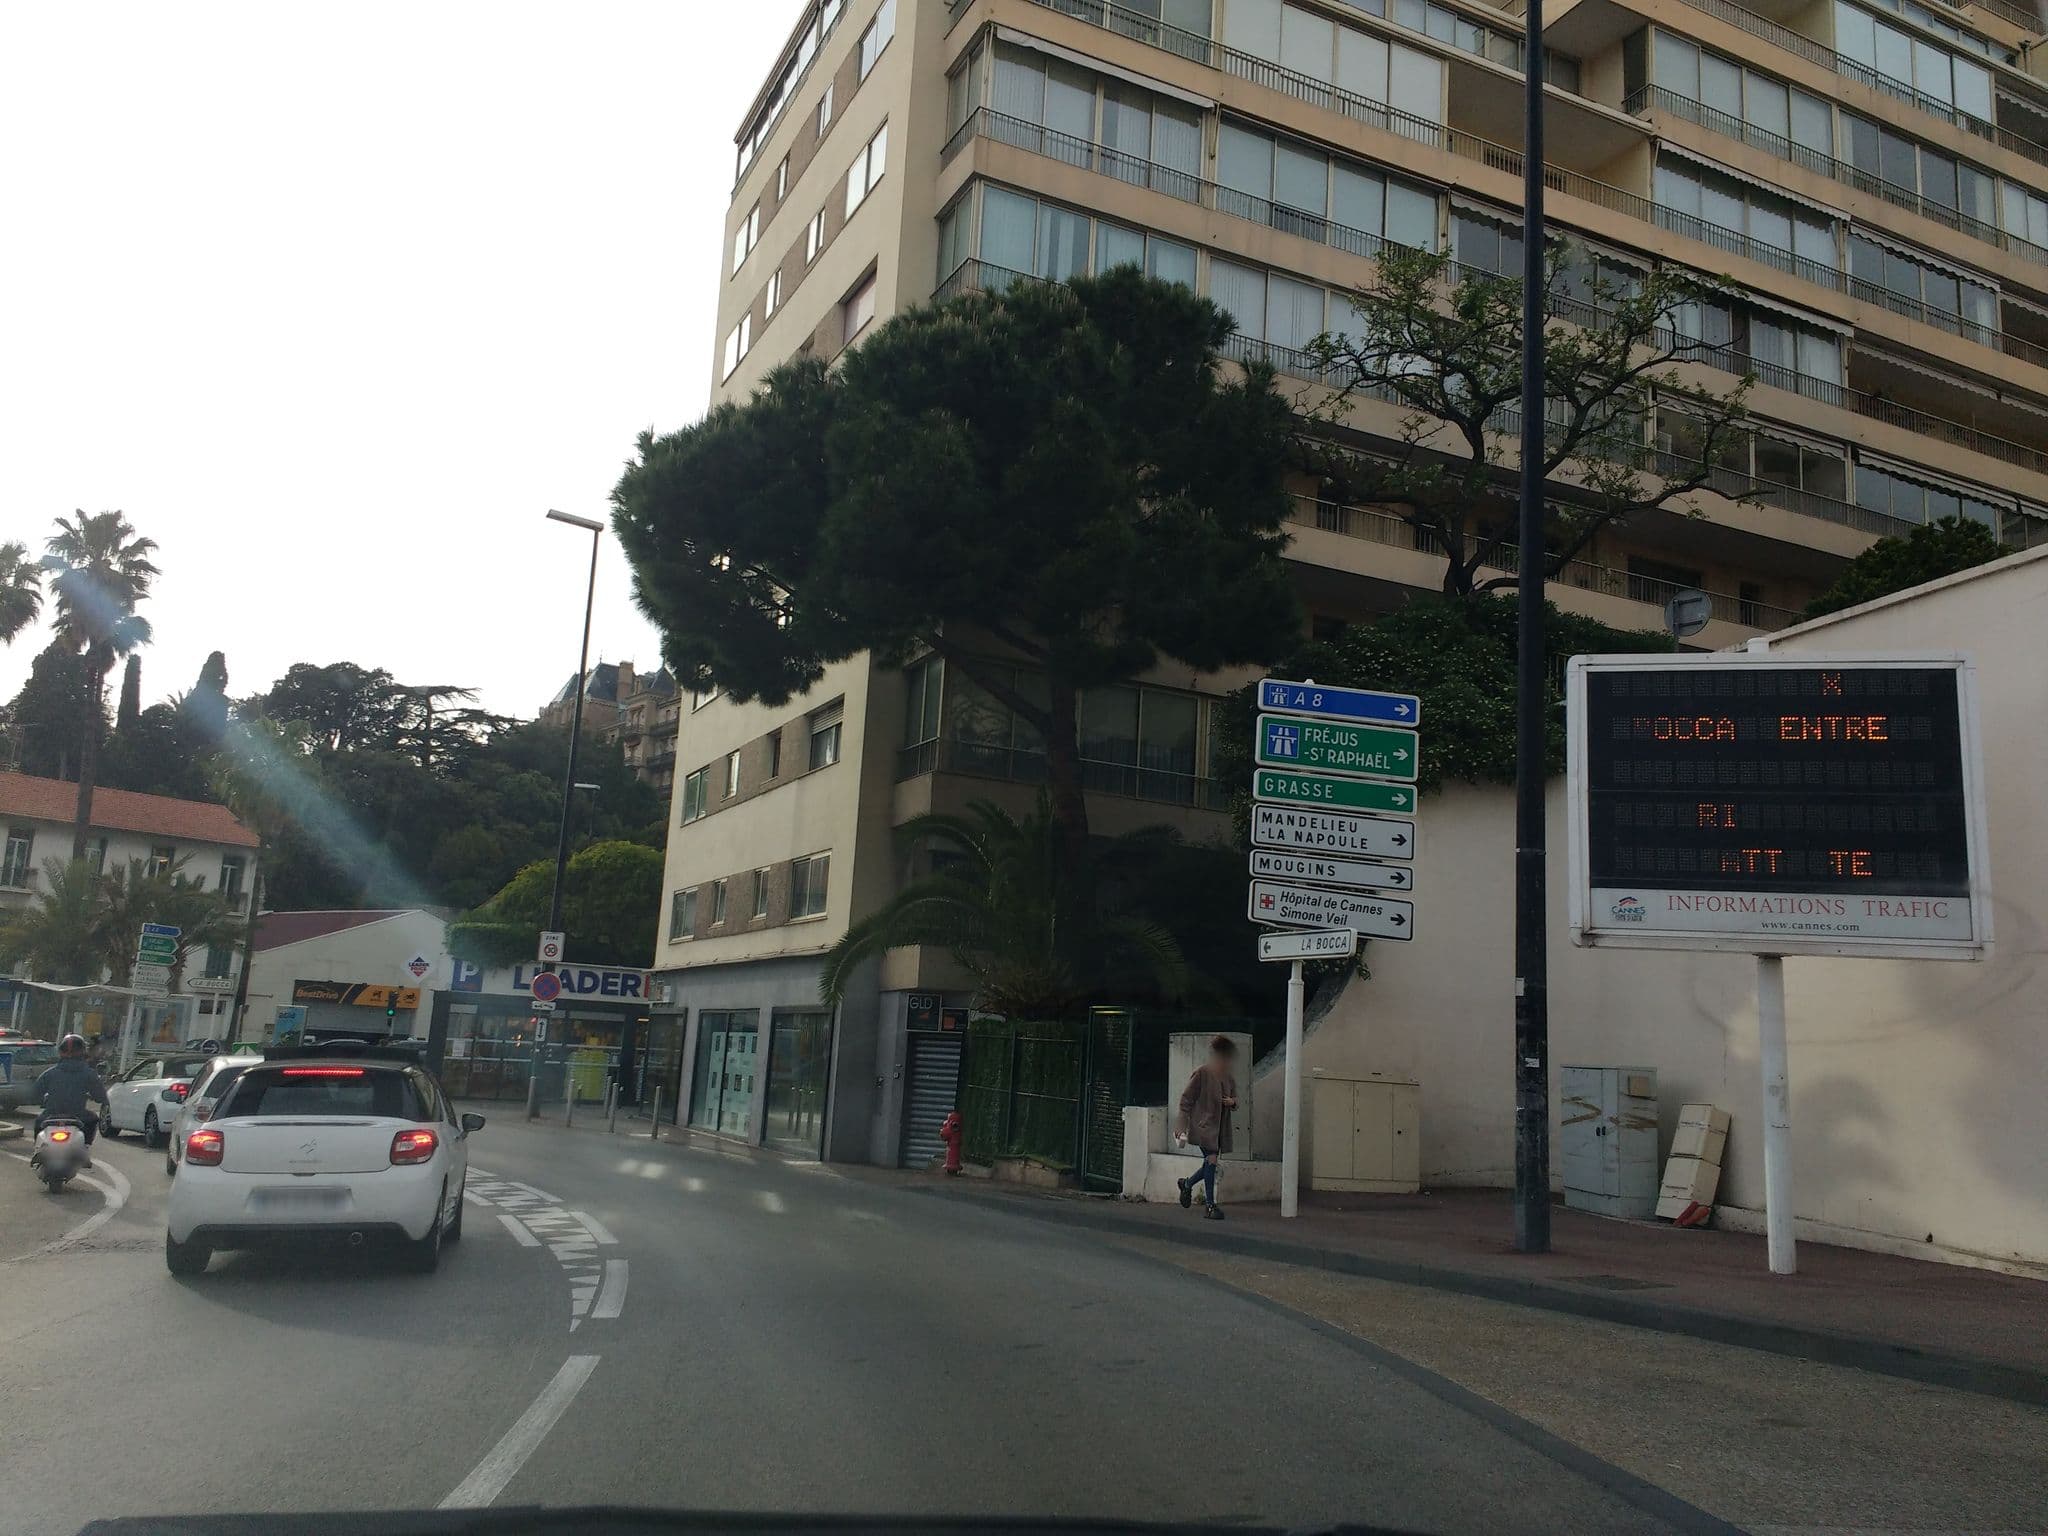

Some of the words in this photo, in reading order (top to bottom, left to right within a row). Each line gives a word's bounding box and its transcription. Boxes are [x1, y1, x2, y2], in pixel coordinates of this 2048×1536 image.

[1293, 691, 1305, 706] A
[1312, 693, 1323, 707] 8
[1304, 727, 1359, 747] FRÉJUS
[1780, 716, 1889, 741] ENTRE
[1327, 748, 1391, 770] RAPHAËL
[1264, 778, 1334, 799] GRASSE
[1262, 811, 1358, 834] MANDELIEU
[1698, 803, 1736, 827] RI
[1294, 830, 1368, 850] NAPOULE
[1259, 857, 1336, 877] MOUGINS
[1280, 890, 1322, 907] Hôpital
[1323, 897, 1338, 910] de
[1340, 899, 1384, 916] Cannes
[1611, 905, 1646, 915] CANNES
[1667, 895, 1846, 916] INFORMATIONS
[1862, 900, 1949, 919] TRAFIC
[1280, 906, 1322, 922] Simone
[1326, 911, 1349, 926] Veil
[1761, 921, 1861, 932] www.cannes.com
[1301, 938, 1312, 951] LA
[1316, 935, 1348, 950] BOCCA
